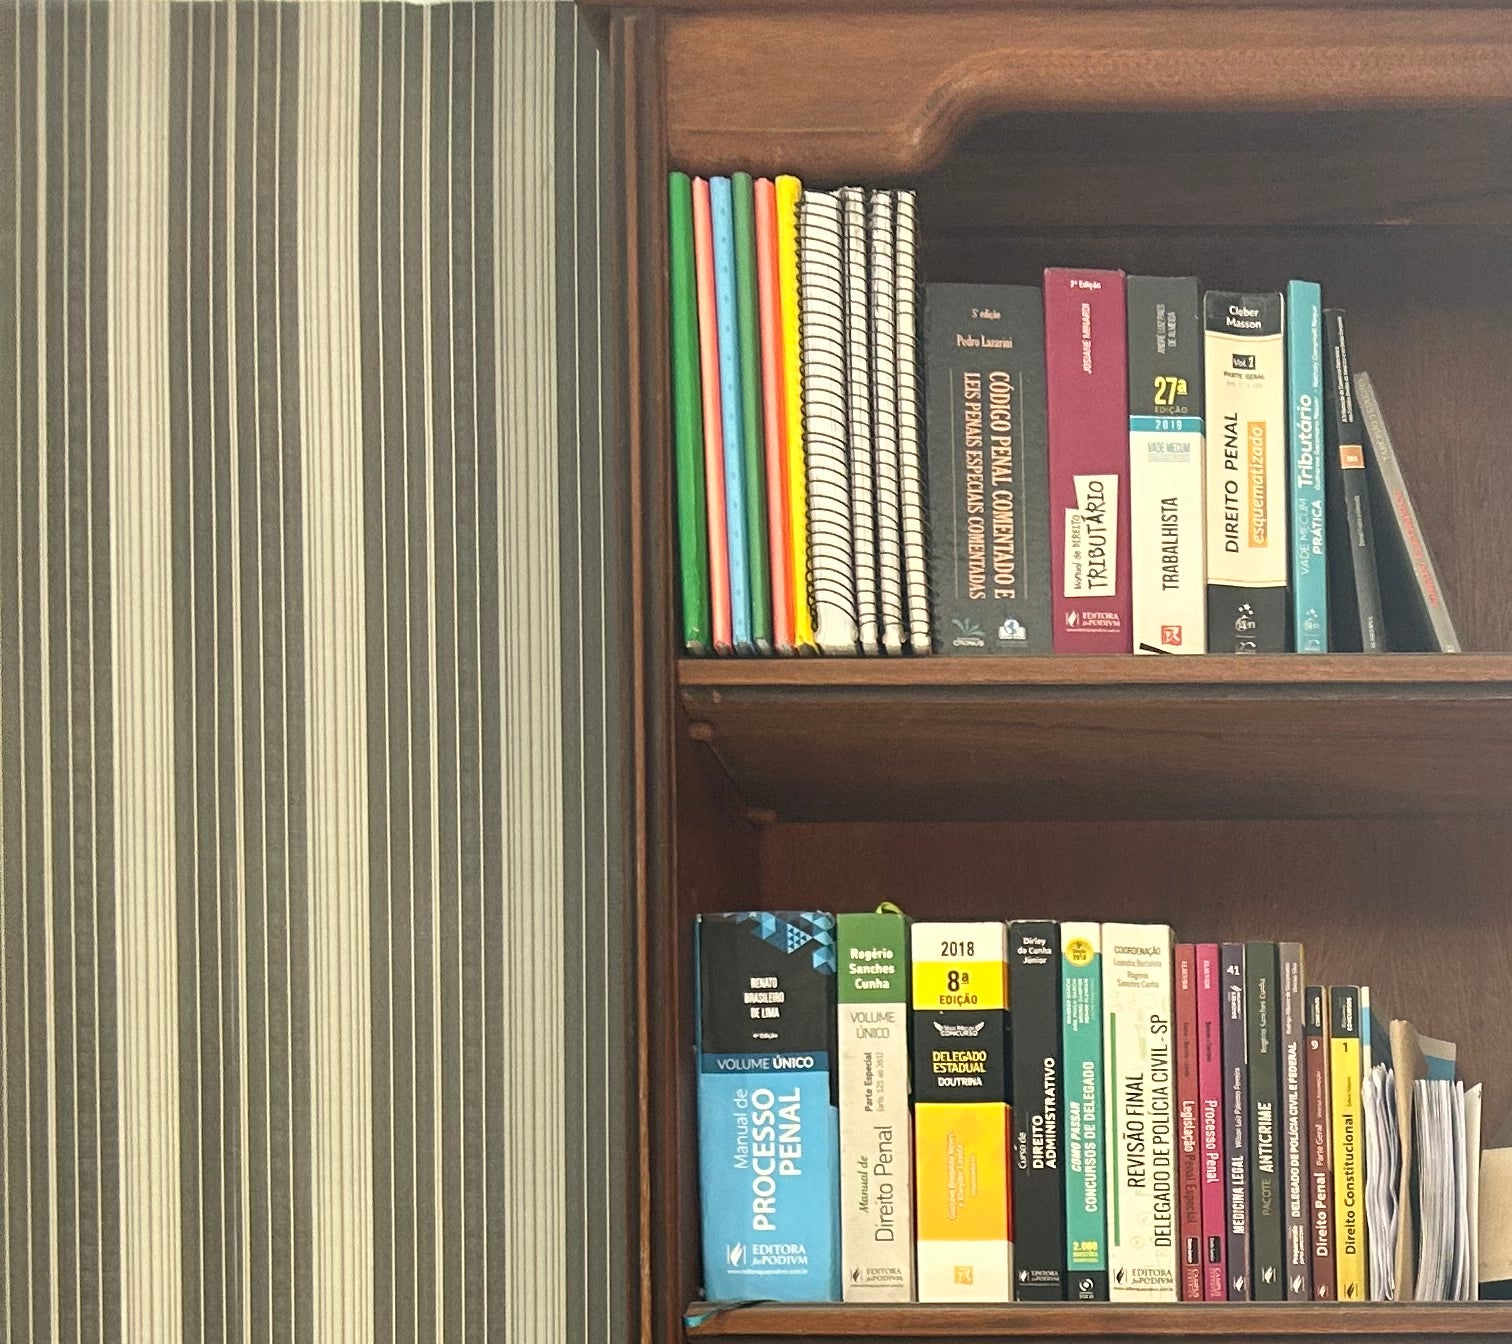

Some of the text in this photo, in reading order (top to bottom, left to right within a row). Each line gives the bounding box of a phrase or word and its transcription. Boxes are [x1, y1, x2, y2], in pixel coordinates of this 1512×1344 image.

[1226, 318, 1262, 329] Masson
[1228, 305, 1259, 317] Cleber
[956, 333, 980, 347] Pedro
[1154, 376, 1188, 405] 27ª
[1154, 405, 1188, 415] EDIÇÃO
[1297, 394, 1313, 489] Tributário
[964, 372, 986, 600] LEIS PENAIS ESPECIAIS COMENTADAS
[989, 371, 1015, 599] CÓDIGO PENAL COMENTADO E
[1224, 412, 1239, 553] DIREITO PENAL
[1249, 426, 1267, 544] esquematizado
[1071, 515, 1082, 548] DIREITO
[1081, 480, 1108, 591] TRIBUTÁRIO
[1299, 498, 1310, 576] VADE MECUM
[1311, 500, 1323, 555] PRÁTICA
[1161, 497, 1180, 591] TRABALHISTA
[1082, 612, 1119, 620] EDITORA
[850, 947, 894, 961] Rogério
[941, 941, 975, 957] 2018
[1022, 937, 1047, 947] Dirley
[1028, 946, 1053, 955] Cunha
[1114, 945, 1161, 957] COORDENAÇÃO
[848, 963, 895, 974] Sanches
[1023, 955, 1048, 965] Júnior
[1226, 965, 1240, 976] 41
[751, 976, 778, 989] RENATO
[854, 978, 890, 989] Cunha
[947, 970, 970, 992] 8ª
[744, 991, 785, 1004] BRASILEIRO
[939, 993, 978, 1007] EDIÇÃO
[751, 1007, 780, 1019] DE LIMA
[850, 1011, 896, 1023] VOLUME
[856, 1025, 890, 1039] ÚNICO
[1310, 1040, 1319, 1050] 9
[932, 1051, 987, 1062] DELEGADO
[1287, 1041, 1298, 1082] FEDERAL
[1342, 1041, 1348, 1053] 1
[717, 1055, 814, 1070] VOLUME ÚNICO
[933, 1062, 987, 1073] ESTADUAL
[864, 1052, 874, 1112] Parte Especial
[937, 1077, 983, 1087] DOUTRINA
[1287, 1083, 1298, 1091] E
[1043, 1057, 1057, 1169] ADMINISTRATIVO
[1147, 1087, 1169, 1145] POLÍCIA
[1287, 1094, 1299, 1116] CIVIL
[733, 1088, 749, 1169] Manual de
[778, 1087, 802, 1175] PENAL
[1069, 1101, 1081, 1173] COMO PASSAR
[1082, 1061, 1097, 1213] CONCURSOS DE DELEGADO
[1123, 1073, 1146, 1188] REVISÃO FINAL
[1180, 1100, 1196, 1153] Legislação
[1257, 1102, 1274, 1173] ANTICRIME
[1288, 1116, 1299, 1153] POLÍCIA
[1315, 1124, 1323, 1145] Geral
[1018, 1131, 1027, 1170] Curso de
[1031, 1115, 1044, 1169] DIREITO
[1204, 1099, 1220, 1184] Processo Penal
[1316, 1145, 1324, 1167] Parte
[752, 1088, 776, 1231] PROCESSO
[1153, 1149, 1170, 1167] DE
[1185, 1154, 1196, 1182] Penal
[1231, 1155, 1244, 1185] LEGAL
[1289, 1154, 1299, 1167] DE
[1343, 1114, 1355, 1207] Constitucional
[857, 1155, 869, 1213] Manual de
[873, 1125, 894, 1242] Direito Penal
[1289, 1168, 1300, 1218] DELEGADO
[1313, 1172, 1327, 1209] Penal
[1153, 1171, 1171, 1247] DELEGADO
[1183, 1183, 1197, 1223] Especial
[1232, 1185, 1245, 1235] MEDICINA
[1315, 1210, 1328, 1257] Direito
[1344, 1210, 1356, 1255] Direito
[752, 1243, 806, 1255] EDITORA
[866, 1267, 902, 1275] EDITORA
[1131, 1269, 1172, 1277] EDITORA
